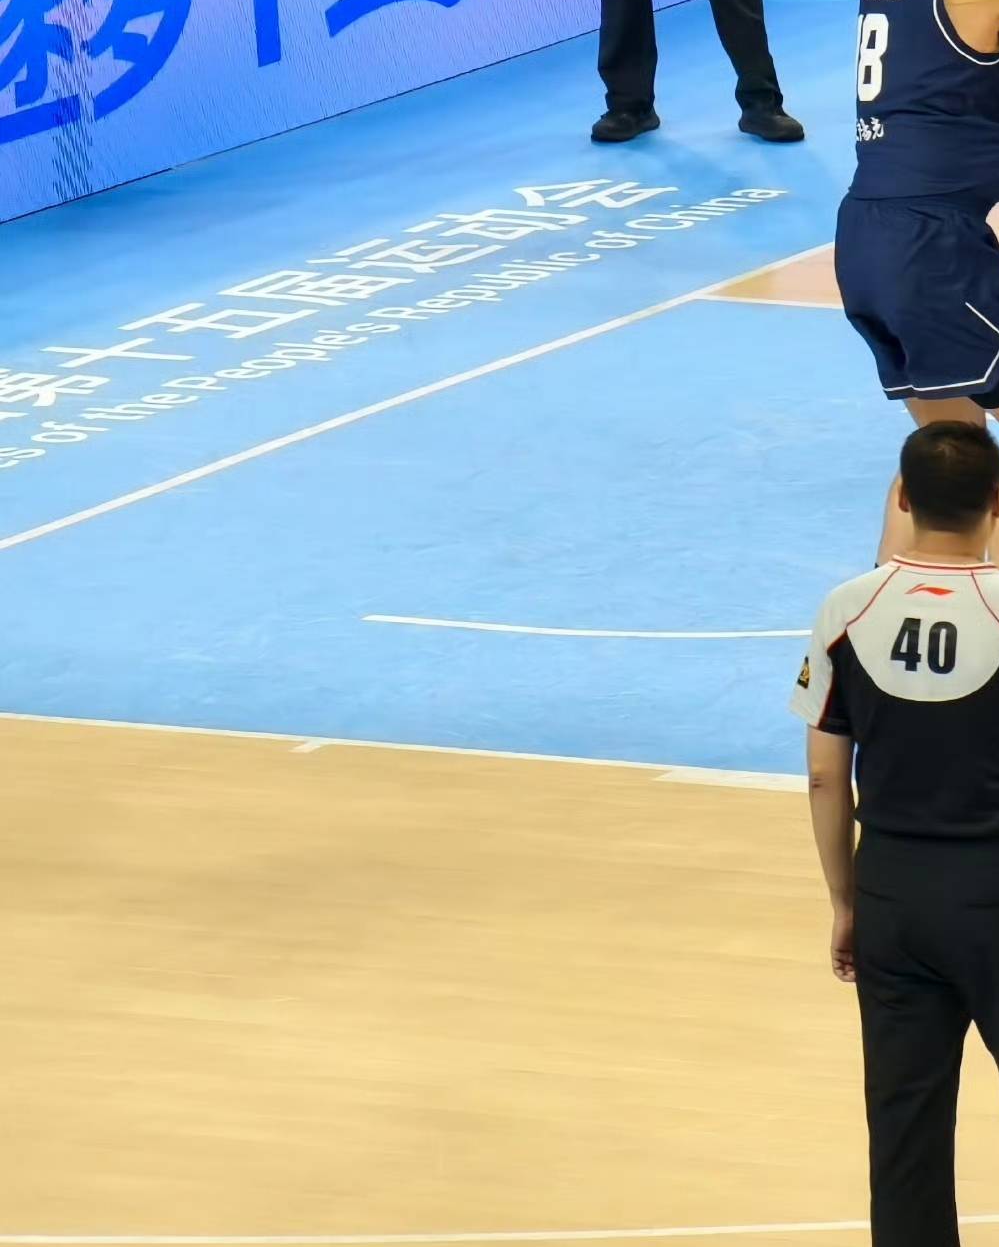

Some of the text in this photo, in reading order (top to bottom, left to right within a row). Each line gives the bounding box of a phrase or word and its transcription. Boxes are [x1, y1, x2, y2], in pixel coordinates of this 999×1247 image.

[31, 421, 110, 443] of
[79, 393, 198, 420] the
[162, 321, 402, 391] People's
[366, 251, 602, 320] Republic
[585, 230, 655, 249] of
[625, 187, 788, 231] China
[890, 617, 958, 675] 40
